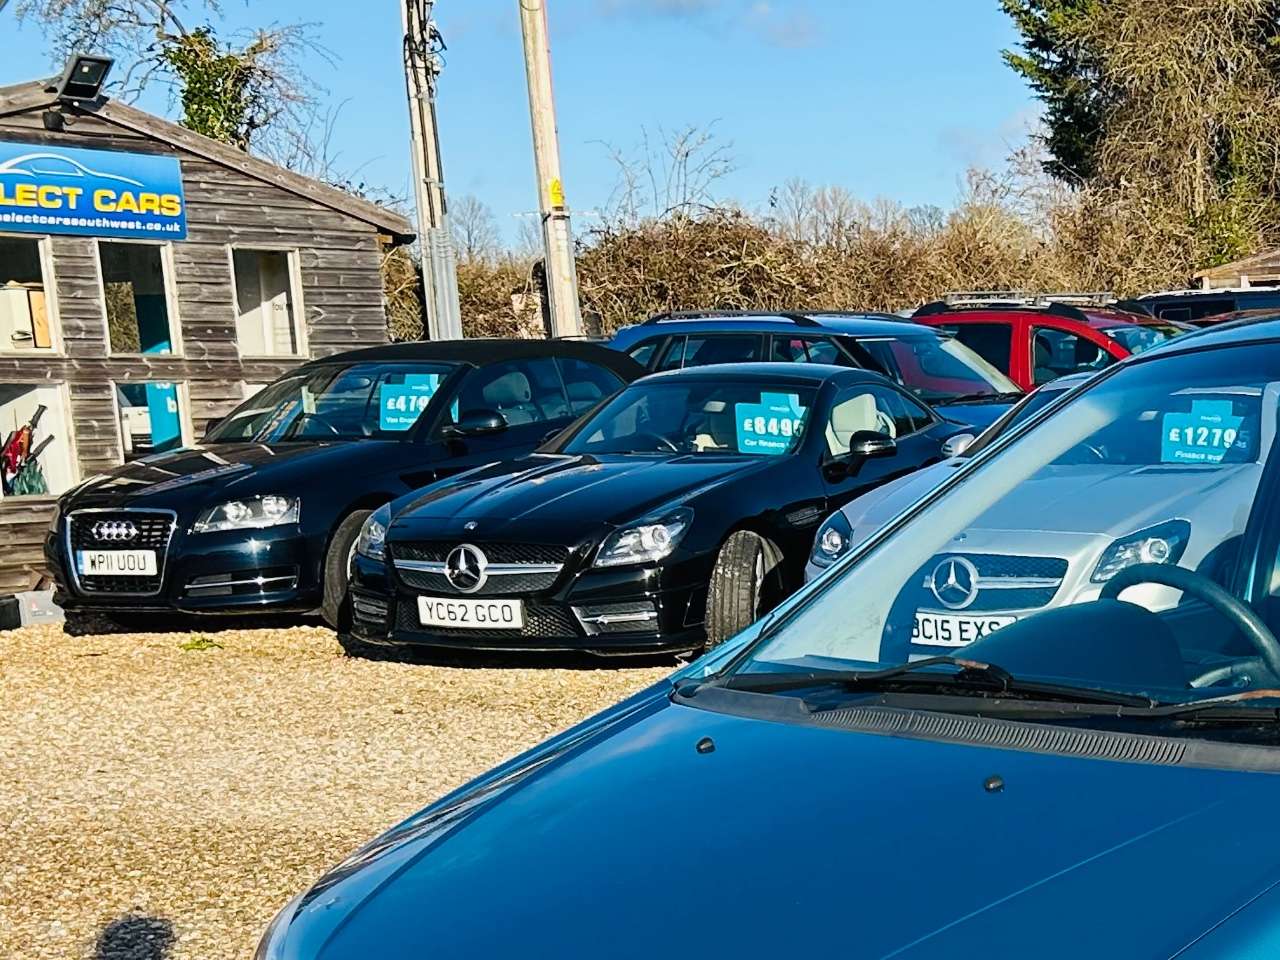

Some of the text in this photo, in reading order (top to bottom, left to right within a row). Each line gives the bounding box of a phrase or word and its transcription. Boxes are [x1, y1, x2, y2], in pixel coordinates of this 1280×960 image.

[93, 189, 182, 217] CARS
[425, 601, 513, 623] YC62 GCO
